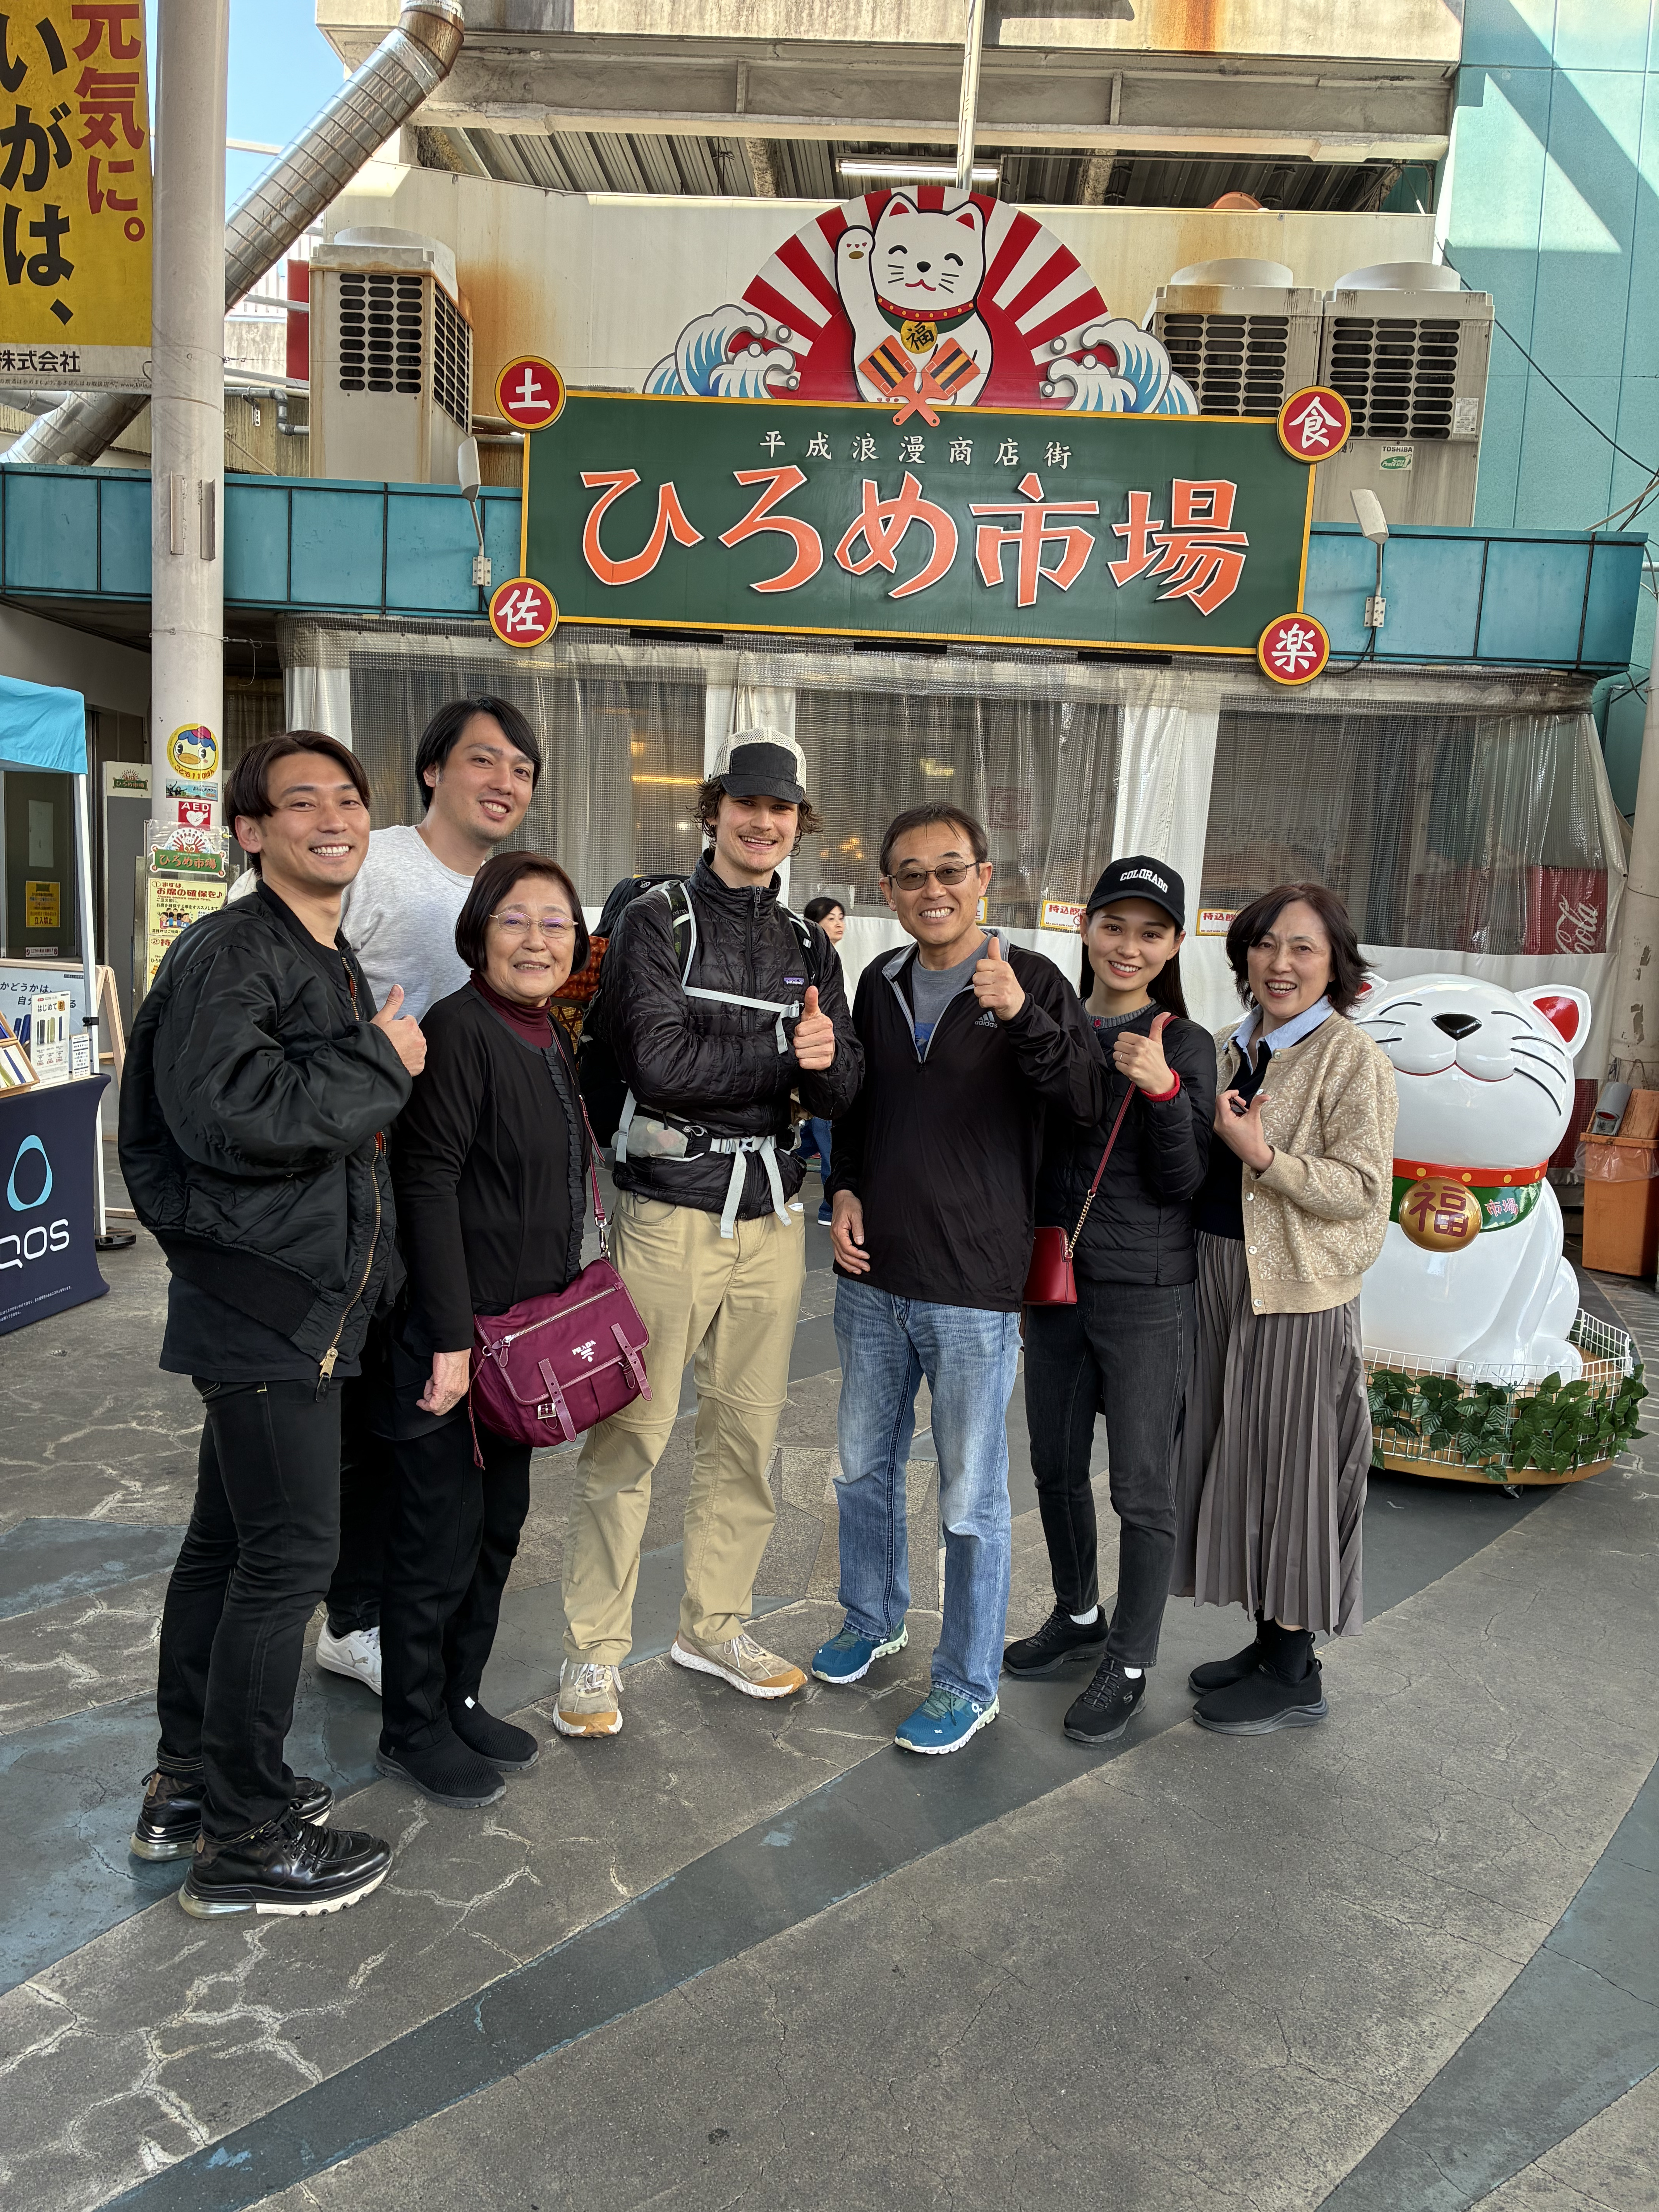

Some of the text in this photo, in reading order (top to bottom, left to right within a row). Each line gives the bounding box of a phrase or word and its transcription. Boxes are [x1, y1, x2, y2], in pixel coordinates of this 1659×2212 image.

[71, 3, 146, 242] 元気に。
[905, 322, 934, 351] 福
[0, 349, 81, 373] 株式会社
[507, 368, 553, 409] 土
[1289, 395, 1342, 449] 食
[758, 430, 1073, 470] 平成浪漫商店街
[581, 464, 1250, 617] ひろめ市場
[496, 590, 546, 633] 佐
[1271, 623, 1318, 673] 楽
[181, 802, 209, 811] AED
[159, 855, 217, 869] ひろめ市場
[1120, 869, 1168, 893] COLORADO
[974, 1020, 998, 1028] adidas
[1409, 1182, 1469, 1237] 福
[1484, 1198, 1519, 1217] 市場
[572, 1340, 596, 1355] PRADA
